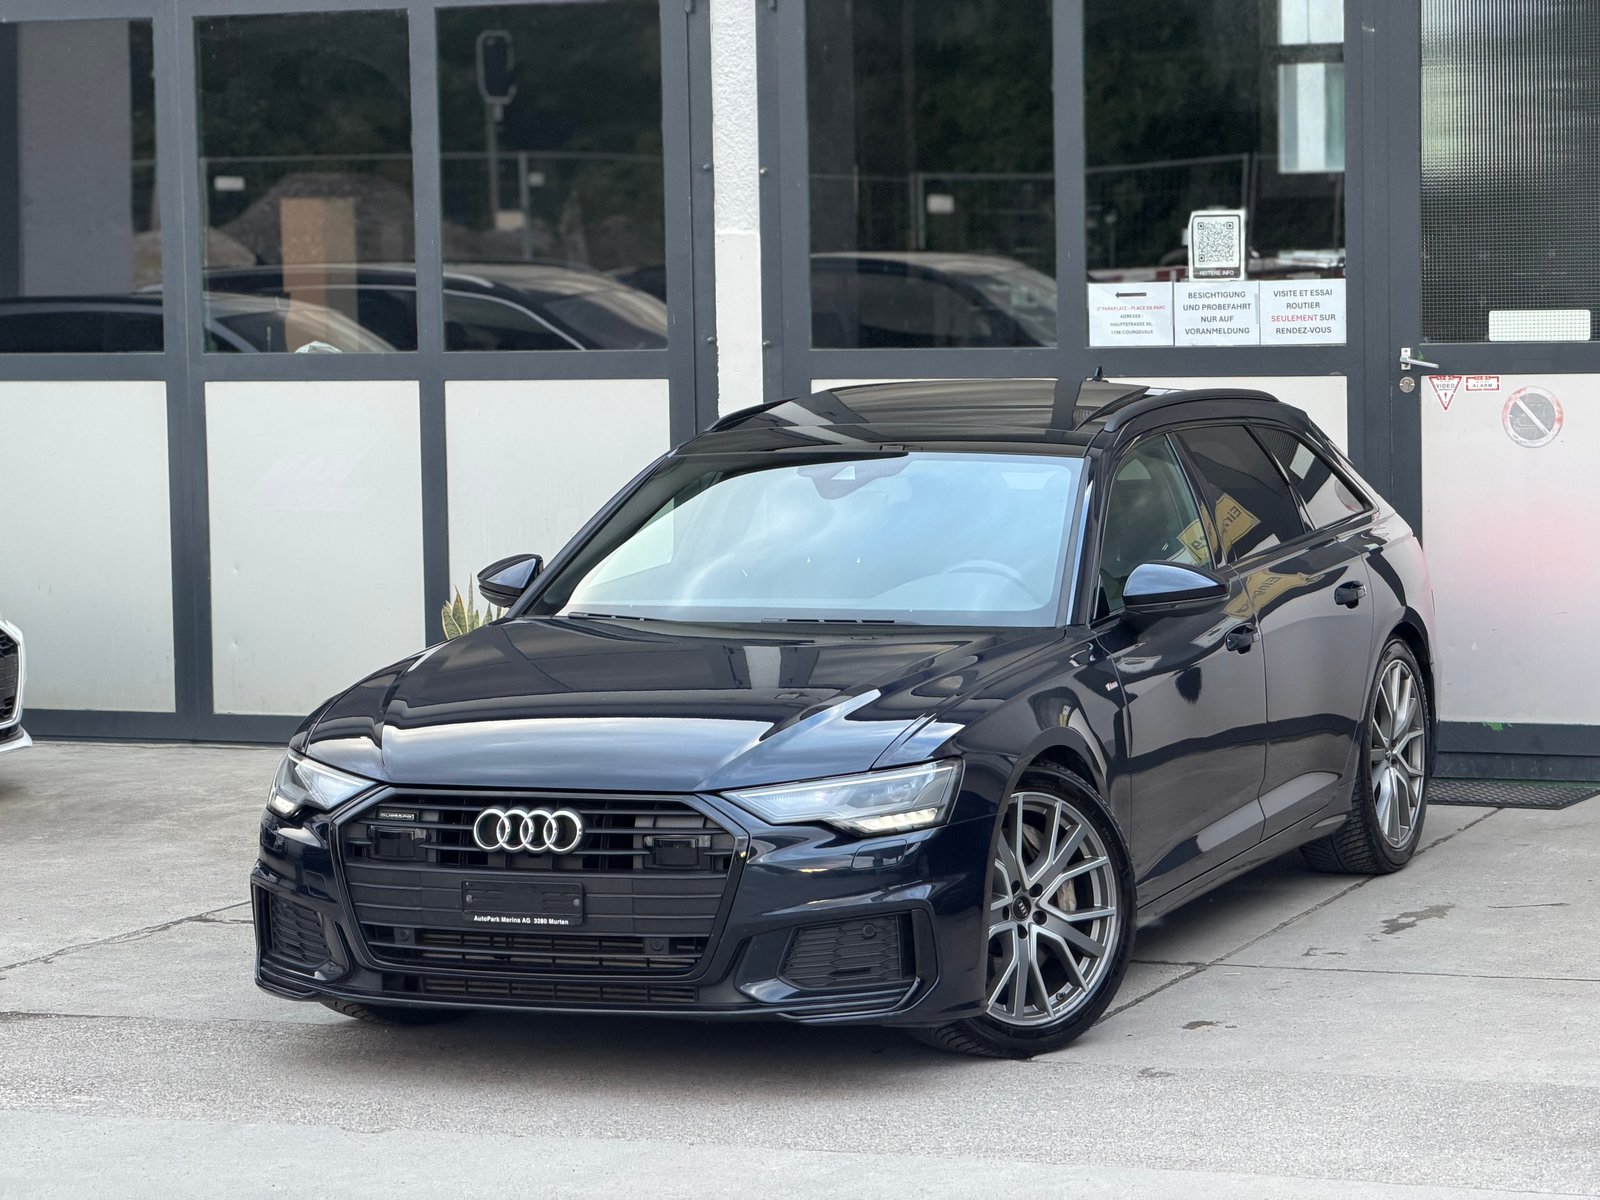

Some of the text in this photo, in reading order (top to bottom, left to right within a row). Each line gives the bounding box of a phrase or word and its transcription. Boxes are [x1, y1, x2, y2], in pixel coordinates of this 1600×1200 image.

[1187, 291, 1246, 299] BESICHTIGUNG
[1273, 289, 1333, 298] VISITE ET ESSAI
[1201, 303, 1252, 311] PROBEFAHRT
[1286, 302, 1321, 310] ROUTIER
[1218, 315, 1235, 323] AUF
[1271, 314, 1318, 323] SEULEMENT
[1184, 327, 1250, 335] VORANMELDUNG
[1275, 326, 1332, 335] RENDEZ-VOUS
